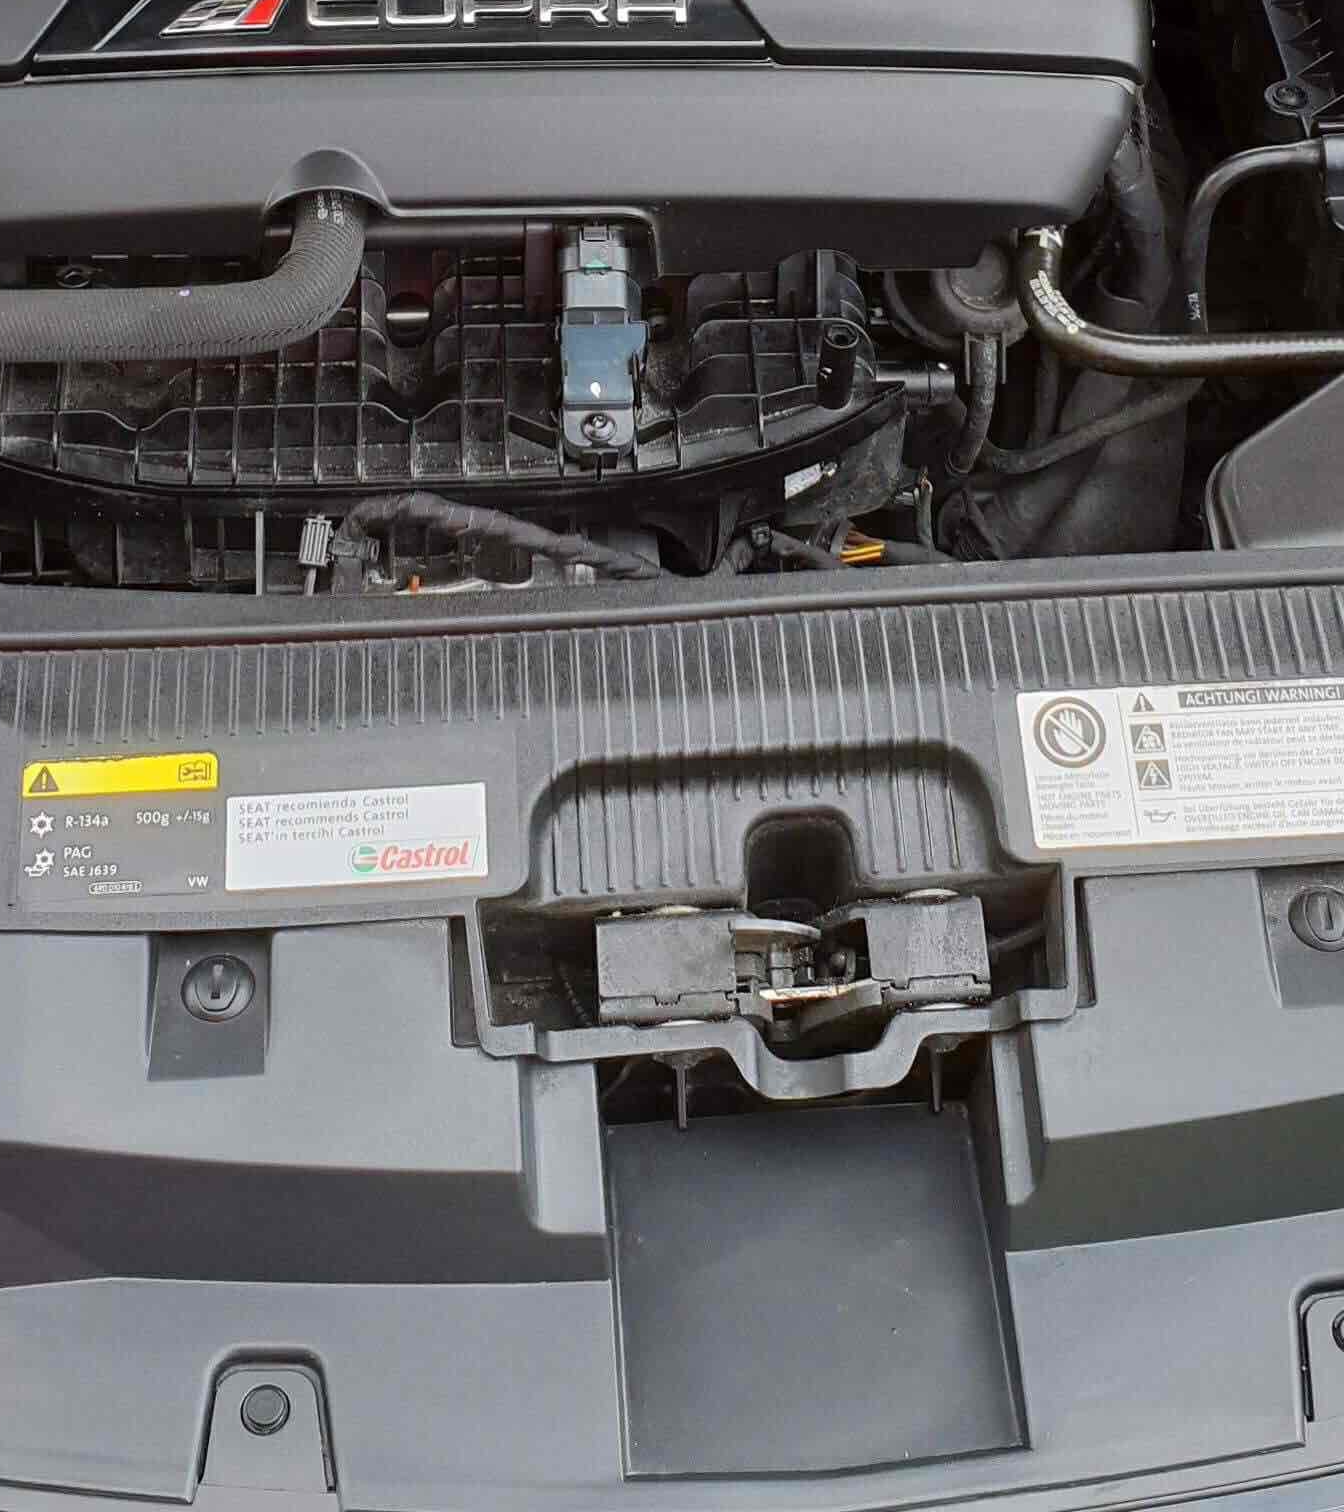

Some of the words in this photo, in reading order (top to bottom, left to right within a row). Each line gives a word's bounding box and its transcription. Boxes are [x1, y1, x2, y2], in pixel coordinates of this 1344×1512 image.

[1185, 690, 1261, 706] ACHTUNG!
[1263, 685, 1341, 703] WARNING!
[239, 800, 270, 816] SEAT
[362, 792, 409, 808] Castrol
[65, 813, 110, 829] R-134a
[135, 810, 171, 828] 500g
[238, 815, 270, 830] SEAT
[275, 809, 360, 827] recommends
[363, 807, 409, 824] Castrol
[338, 823, 385, 840] Castrol
[63, 844, 93, 860] PAG
[379, 840, 470, 872] Castrol
[63, 864, 87, 879] SAE
[186, 874, 210, 889] VW
